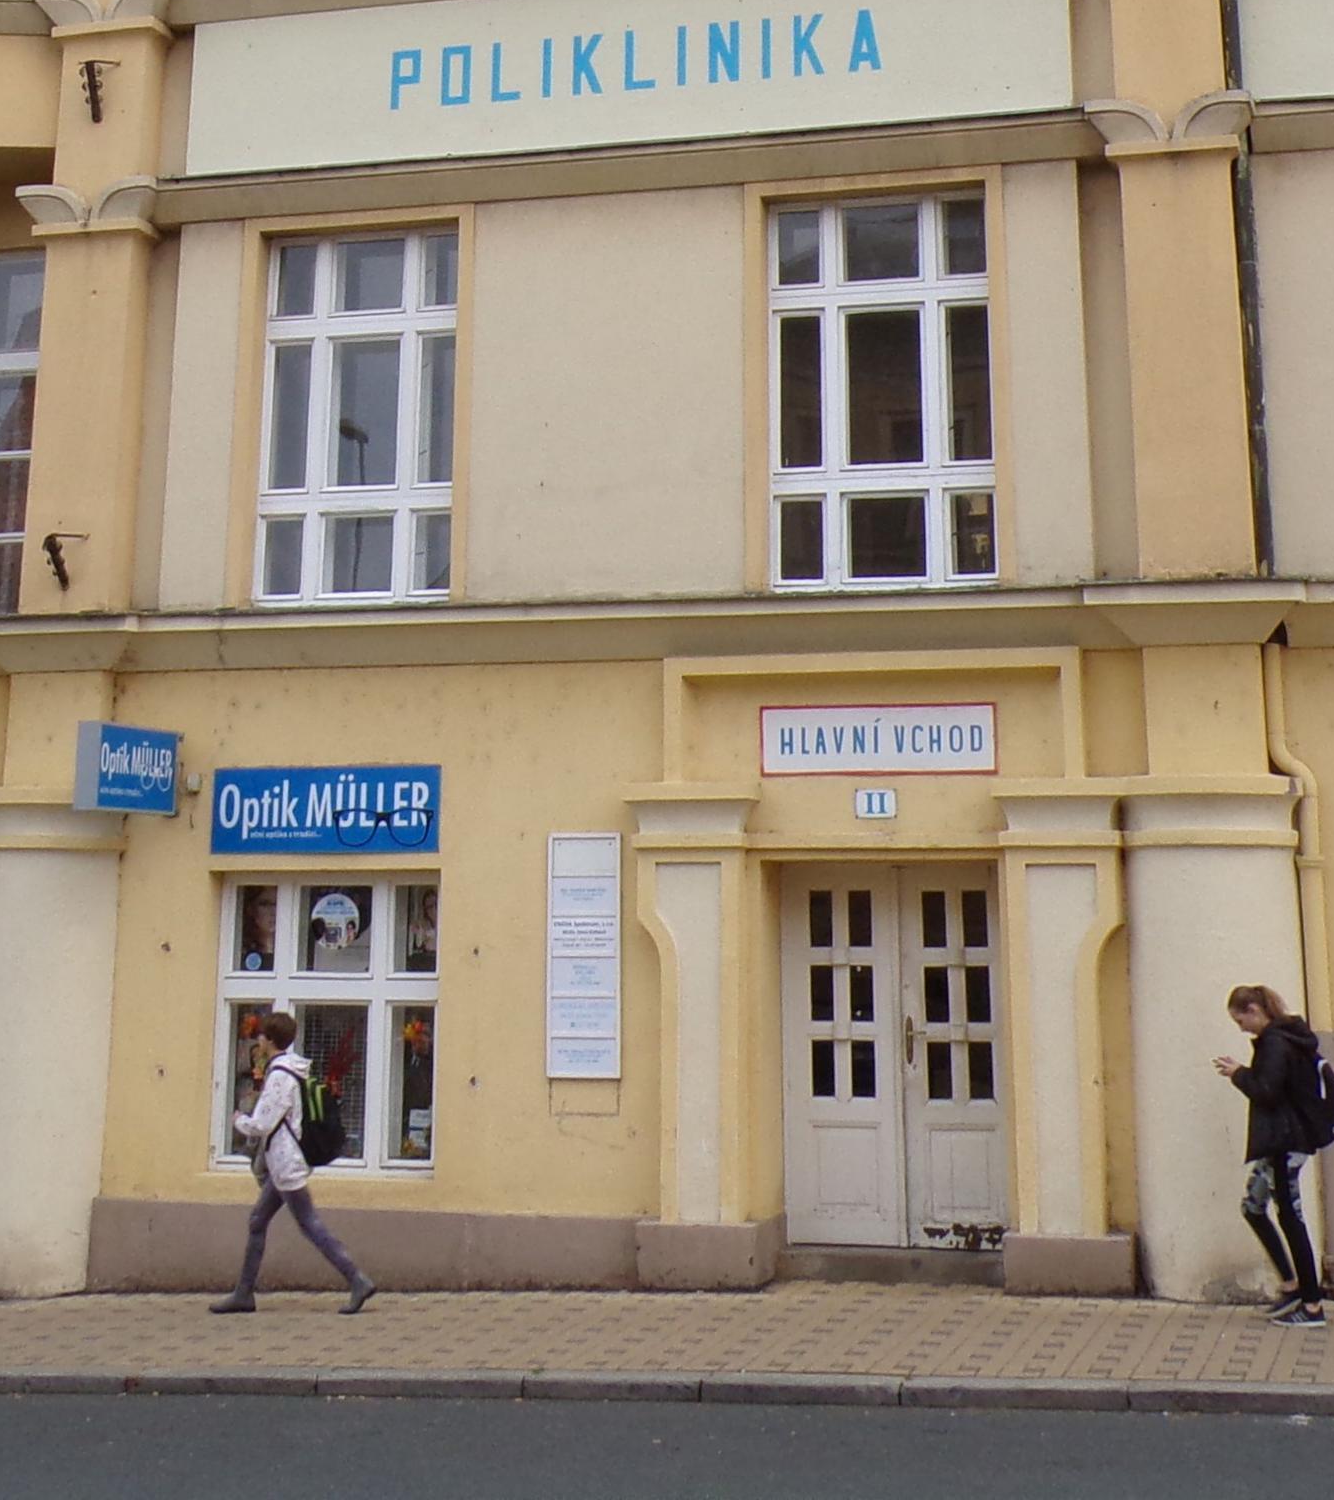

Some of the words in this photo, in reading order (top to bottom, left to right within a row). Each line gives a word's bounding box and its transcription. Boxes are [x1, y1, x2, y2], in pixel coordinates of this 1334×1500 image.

[389, 9, 882, 110] POLIKLINIKA
[100, 741, 131, 781] Optik
[130, 740, 173, 778] MÜLLER
[780, 718, 882, 755] HLAVNÍ
[893, 725, 984, 753] VCHOD
[218, 779, 299, 840] Optik
[305, 773, 430, 828] MÜLLER
